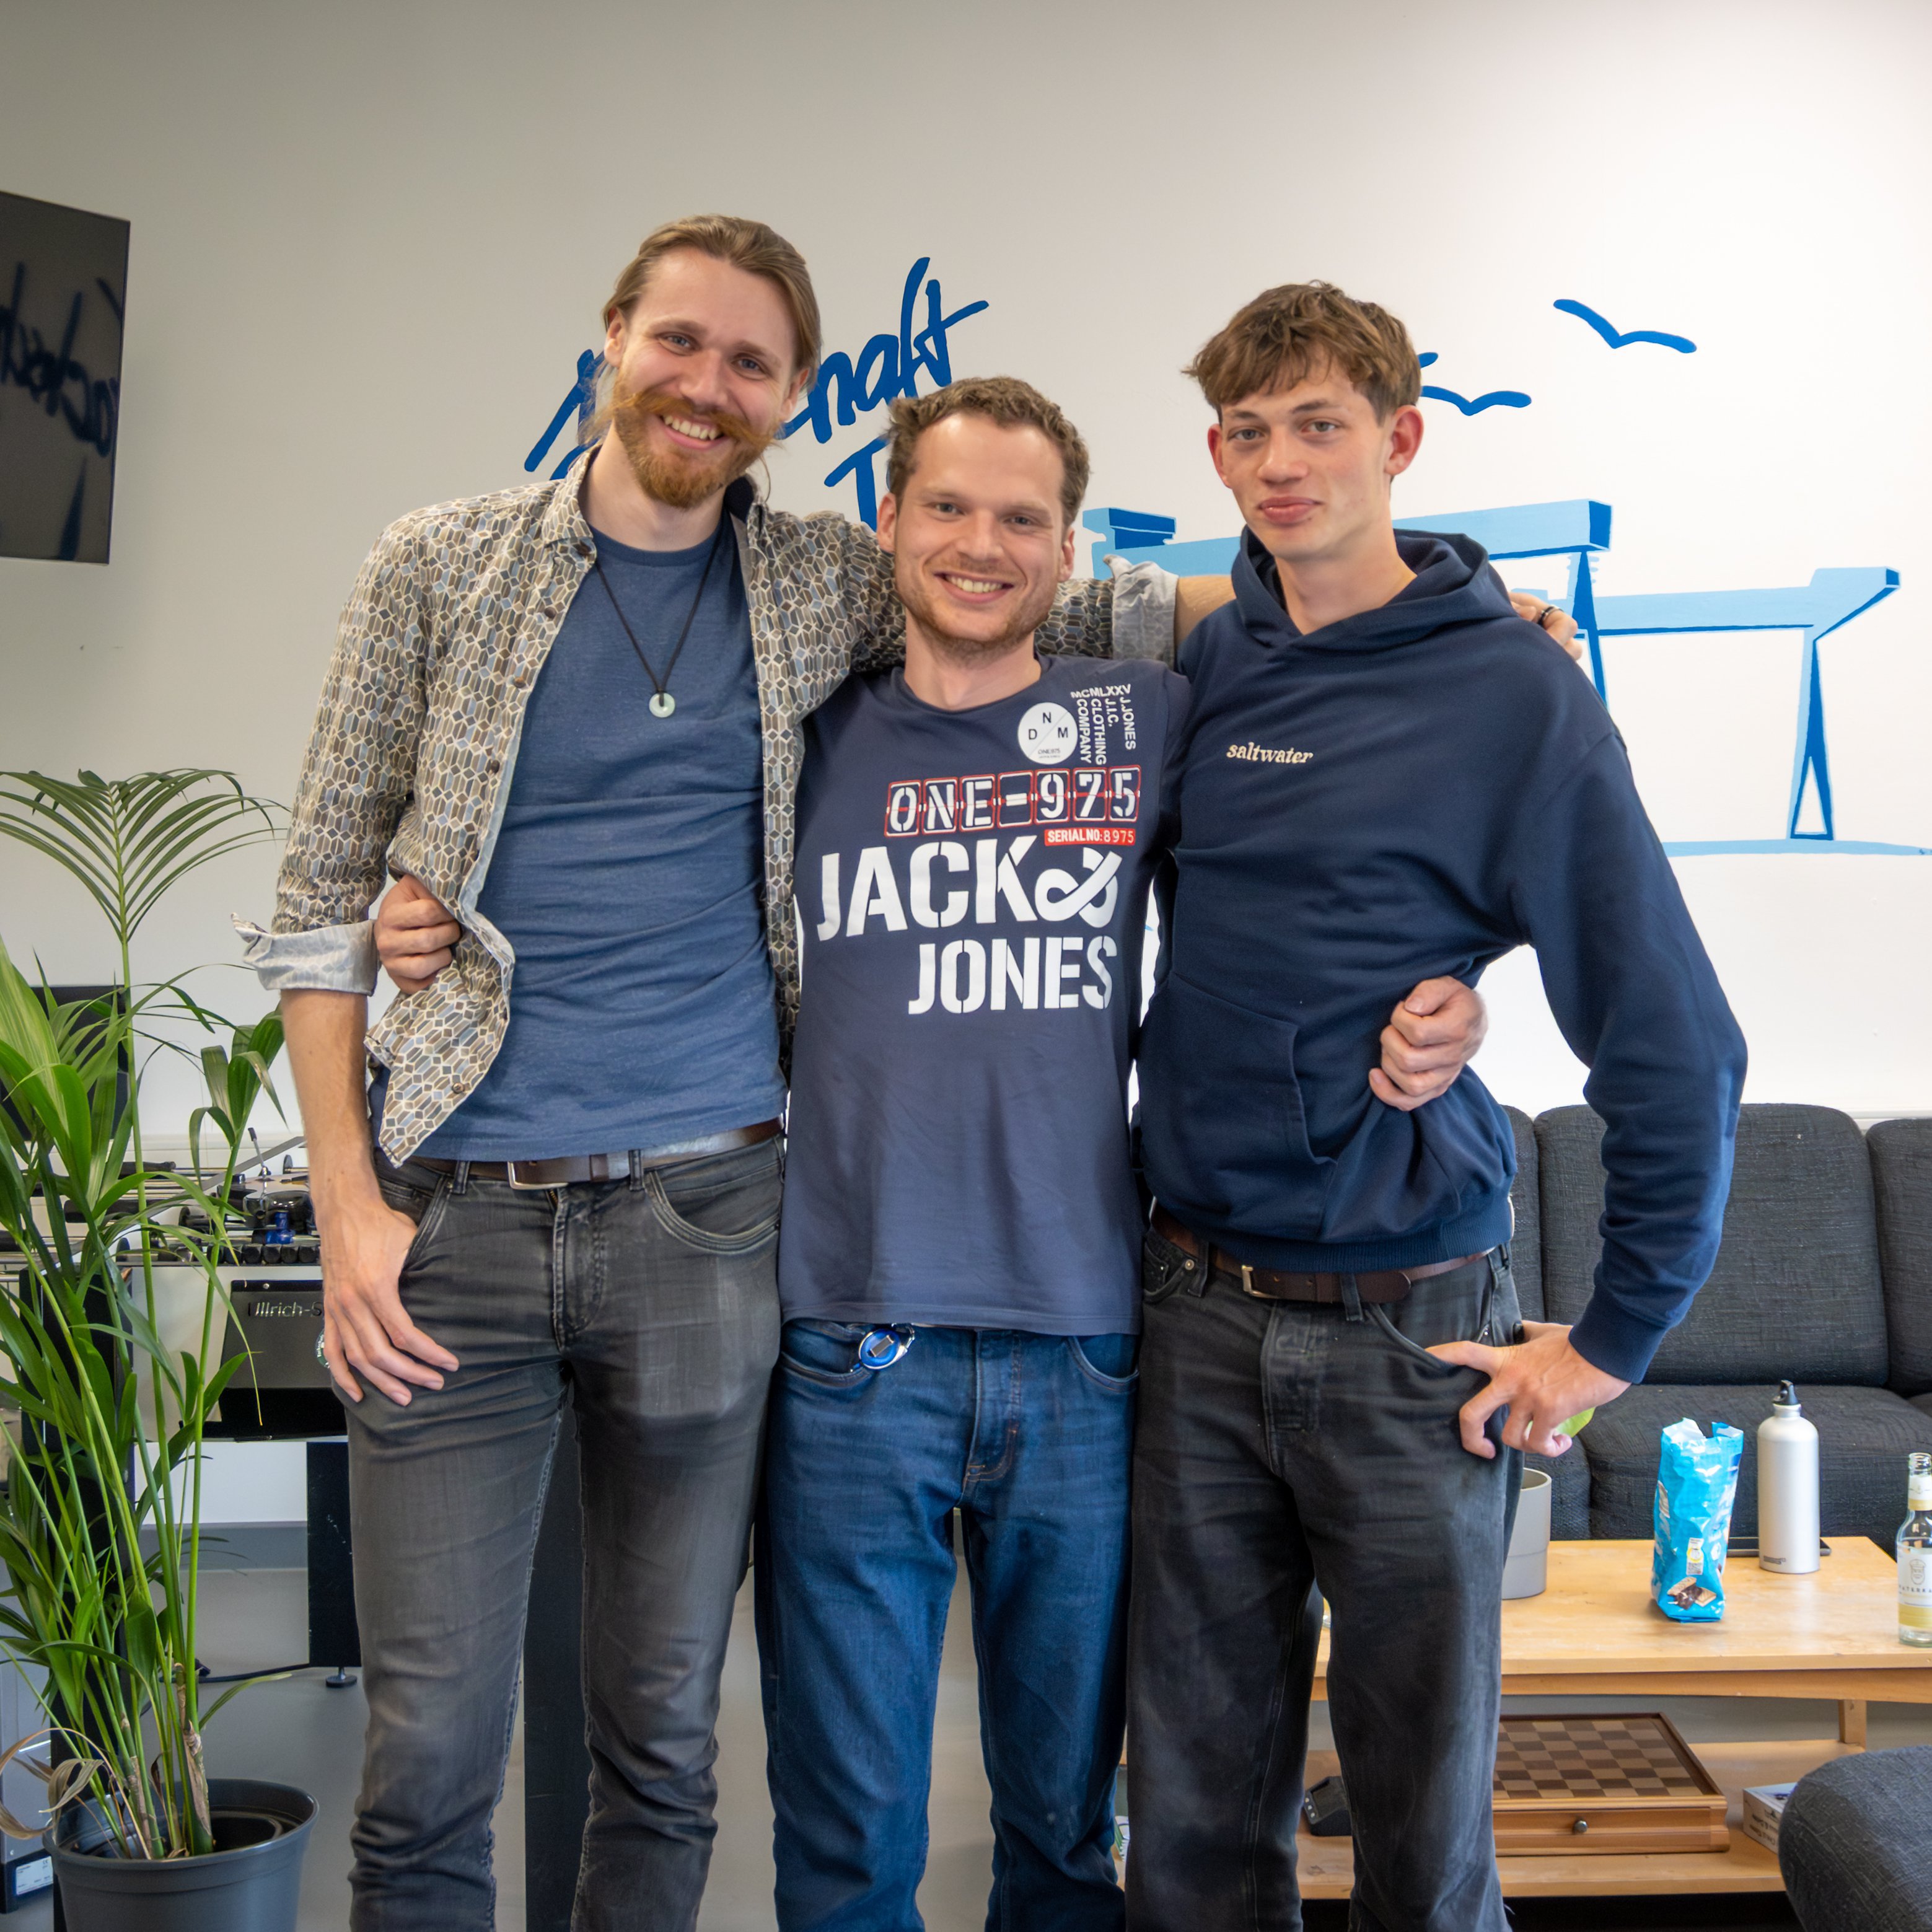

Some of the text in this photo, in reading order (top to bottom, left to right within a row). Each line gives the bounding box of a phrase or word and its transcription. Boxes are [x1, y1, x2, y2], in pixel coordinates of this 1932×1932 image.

[1070, 683, 1131, 698] MCMLXXV
[1028, 727, 1068, 740] D M
[1042, 712, 1052, 724] N
[1076, 699, 1092, 764] COMPANY
[1091, 699, 1107, 765] CLOTHING
[1120, 697, 1136, 750] J.JONES
[1226, 742, 1314, 764] saltwater
[889, 772, 1136, 832] ONE-975
[1047, 829, 1086, 843] SERIAL
[1104, 830, 1134, 843] 8975
[817, 835, 1038, 942] JACK
[908, 935, 1117, 1014] JONES
